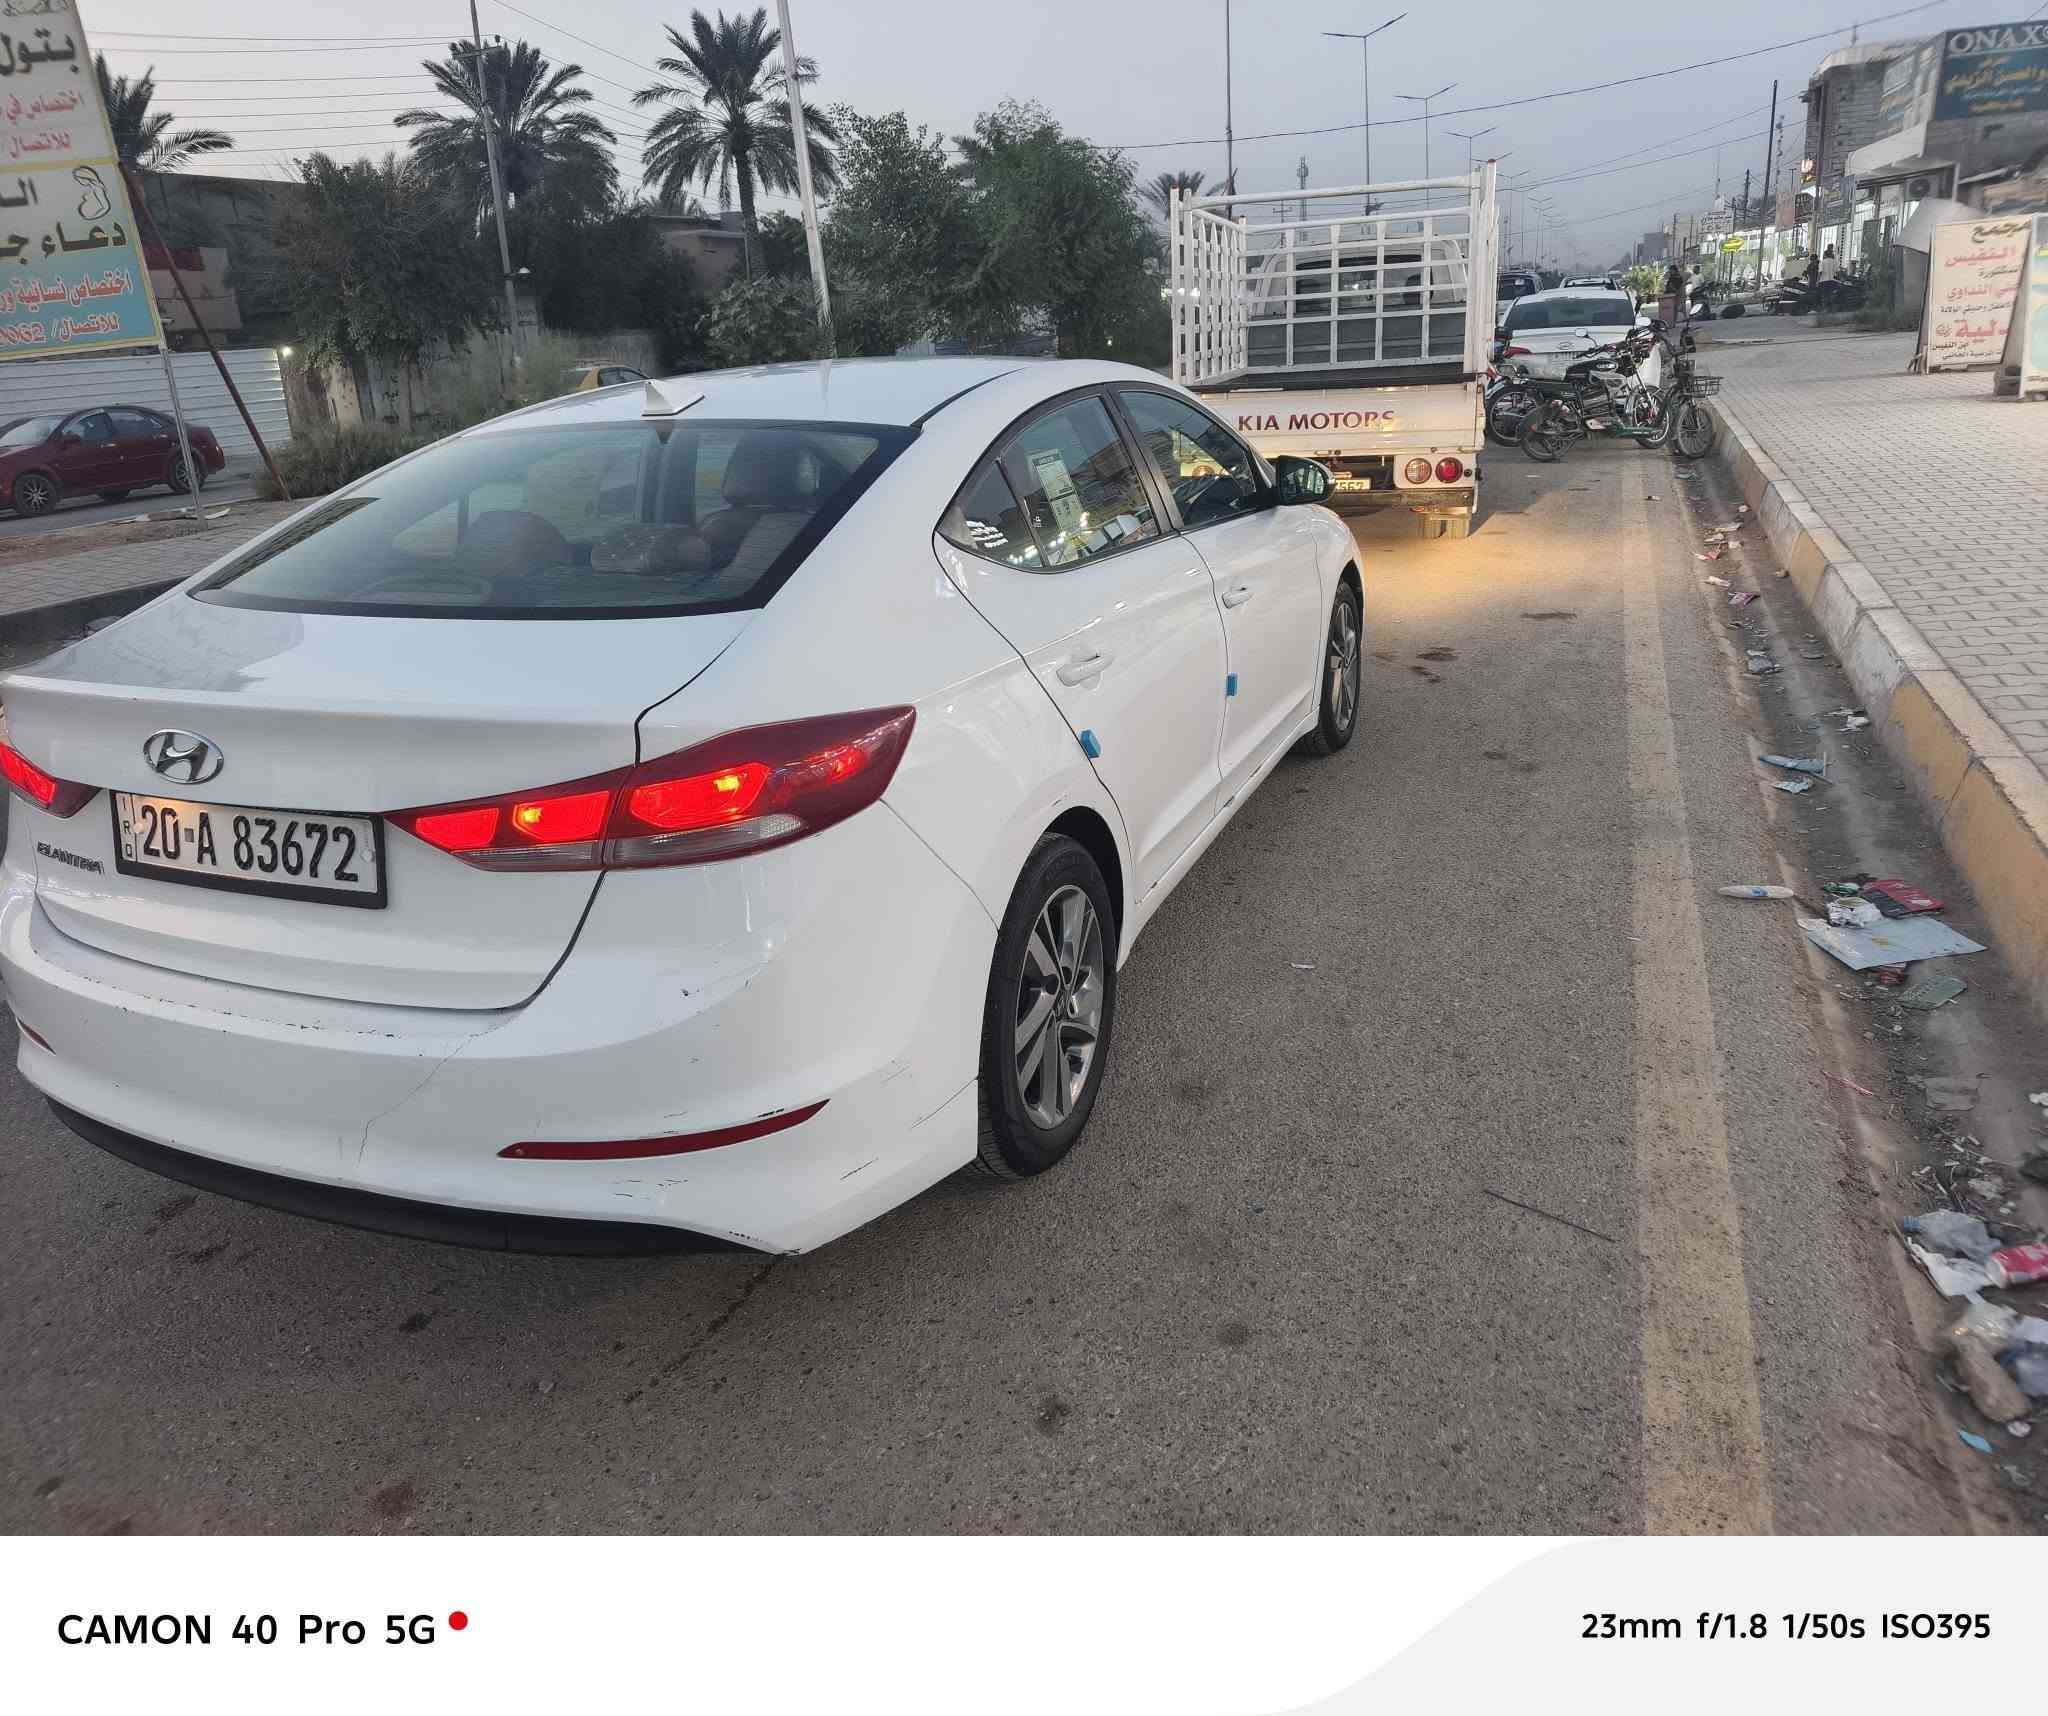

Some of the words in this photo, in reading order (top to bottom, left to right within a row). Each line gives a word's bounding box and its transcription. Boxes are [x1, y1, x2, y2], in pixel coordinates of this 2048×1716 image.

[0, 27, 79, 76] بتول
[9, 128, 71, 158] للاتصال
[41, 221, 127, 258] دعاء
[1971, 220, 2032, 243] مجمع
[70, 268, 133, 307] اختصاص
[1239, 415, 1280, 431] KIA
[1288, 410, 1395, 431] MOTORS
[233, 815, 359, 882] 83672
